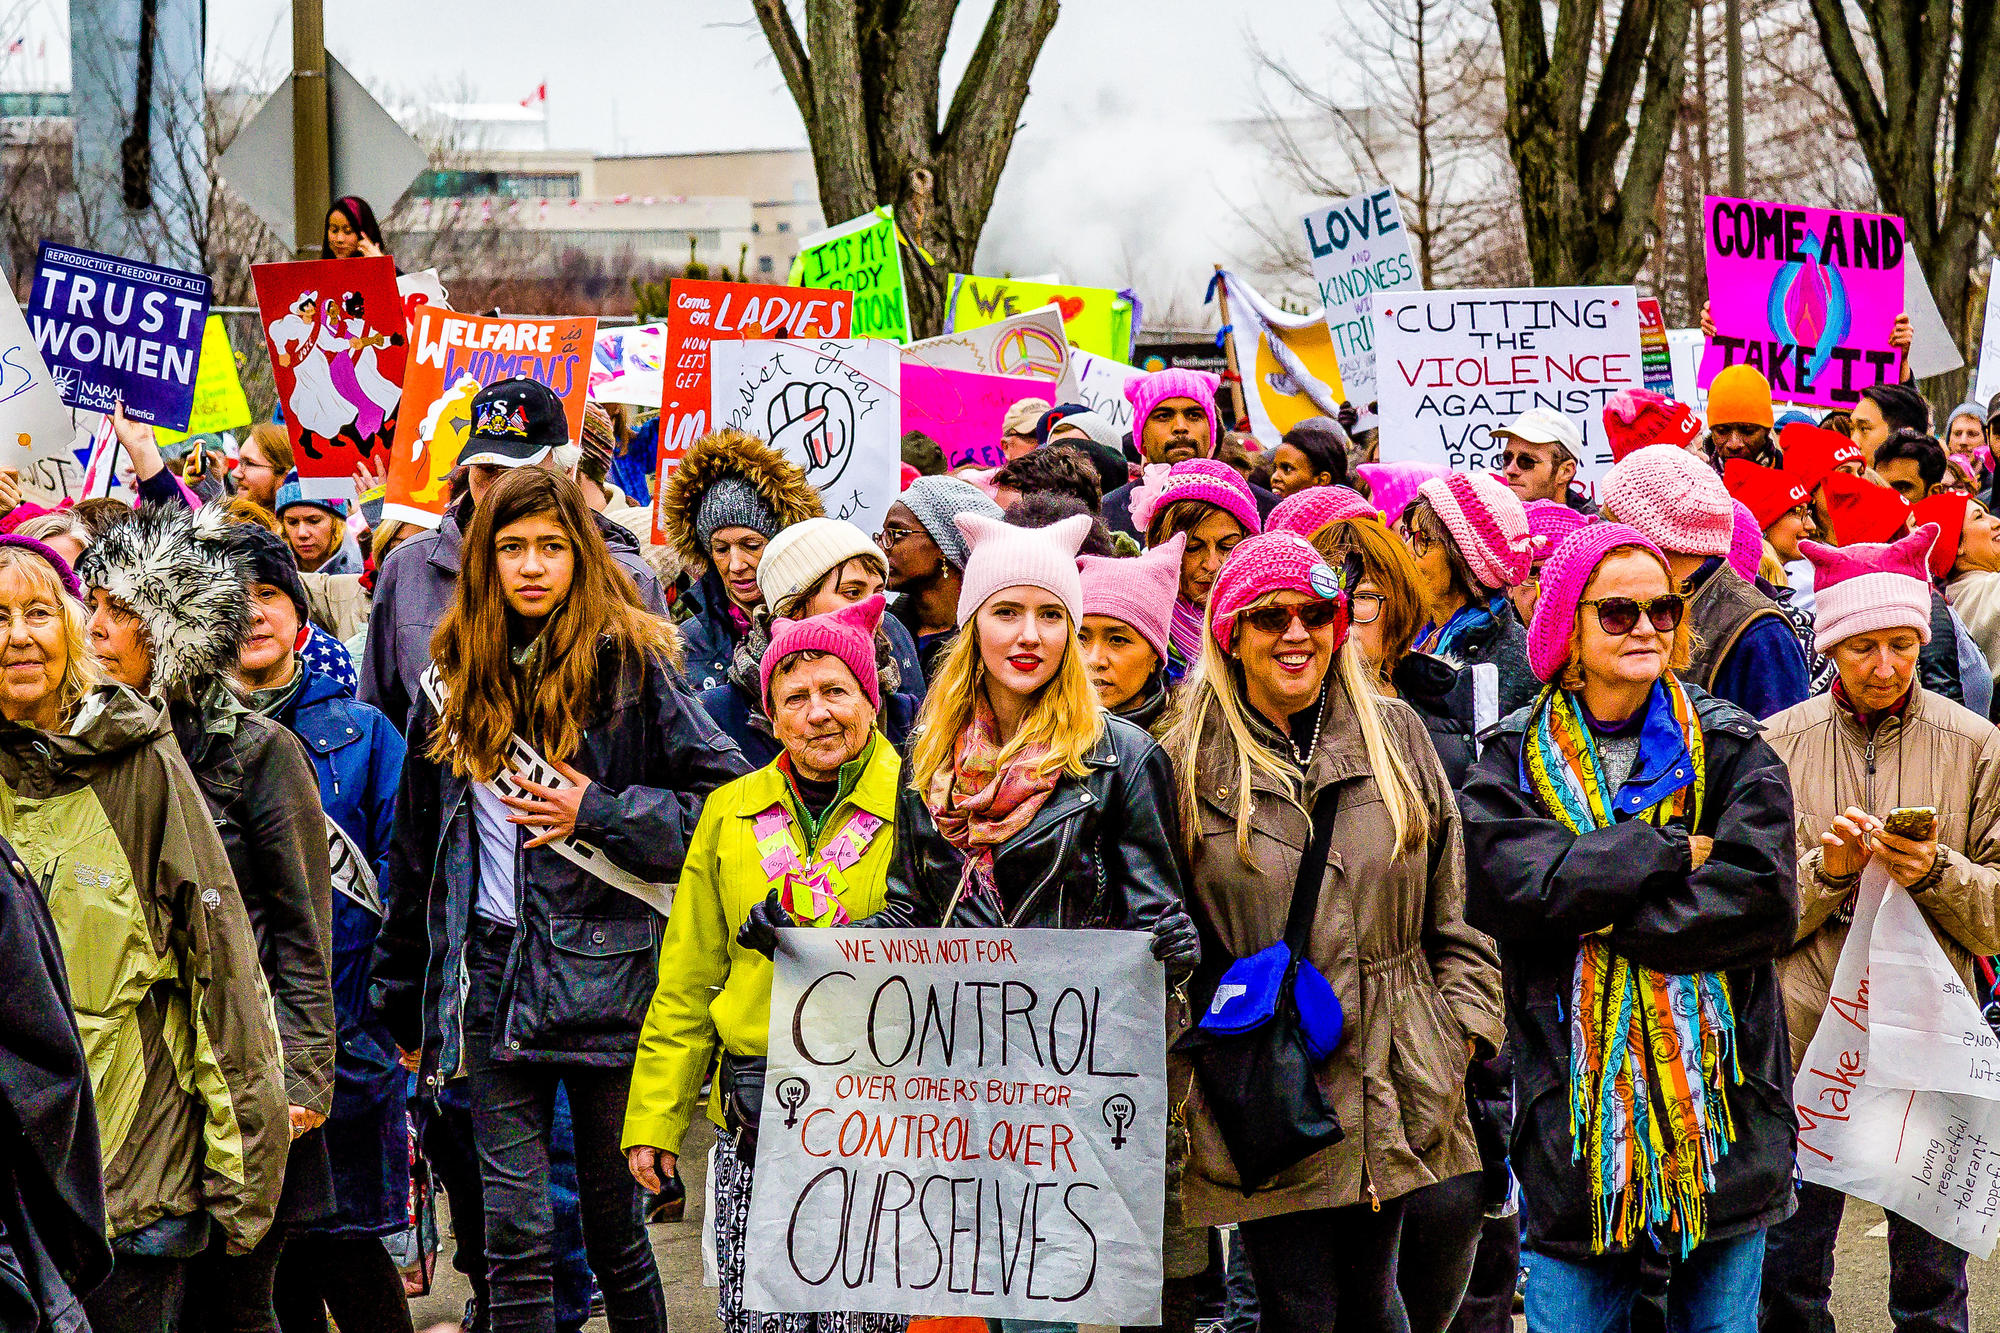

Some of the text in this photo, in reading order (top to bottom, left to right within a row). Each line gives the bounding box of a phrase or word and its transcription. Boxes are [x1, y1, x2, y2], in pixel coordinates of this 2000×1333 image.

[860, 226, 889, 263] MY
[1304, 190, 1400, 259] LOVE
[1713, 203, 1905, 270] COME AND
[47, 251, 201, 291] REPRODUCTIVE FREEDOM FOR ALL
[1352, 250, 1371, 264] AND
[677, 293, 711, 309] Come
[970, 282, 1021, 319] WE
[1319, 254, 1412, 309] KINDNESS
[41, 267, 202, 340] TRUST
[690, 311, 710, 326] on
[714, 293, 845, 338] LADIES
[1396, 300, 1607, 332] CUTTING
[33, 315, 193, 385] WOMEN
[416, 315, 582, 369] WELFARE is
[562, 341, 578, 353] a
[682, 337, 710, 351] NOW
[1468, 333, 1536, 350] THE
[443, 348, 580, 399] WOMEN'S
[676, 372, 702, 389] GET
[1397, 354, 1632, 387] VIOLENCE
[1712, 335, 1895, 402] TAKE IT
[81, 381, 124, 402] NARAL
[1415, 388, 1620, 419] AGAINST
[125, 405, 155, 421] America
[664, 401, 705, 451] in
[836, 938, 1018, 964] WE WISH NOT FOR
[792, 971, 1138, 1077] CONTROL
[836, 1075, 1071, 1108] OVER OTHERS BUT FOR
[1797, 1050, 1866, 1163] Make
[802, 1108, 1078, 1172] CONTROL OVER
[1937, 1114, 1969, 1196] respectful
[1912, 1138, 1945, 1186] loving
[1953, 1134, 1988, 1209] tolerant
[786, 1166, 1099, 1303] OURSELVES
